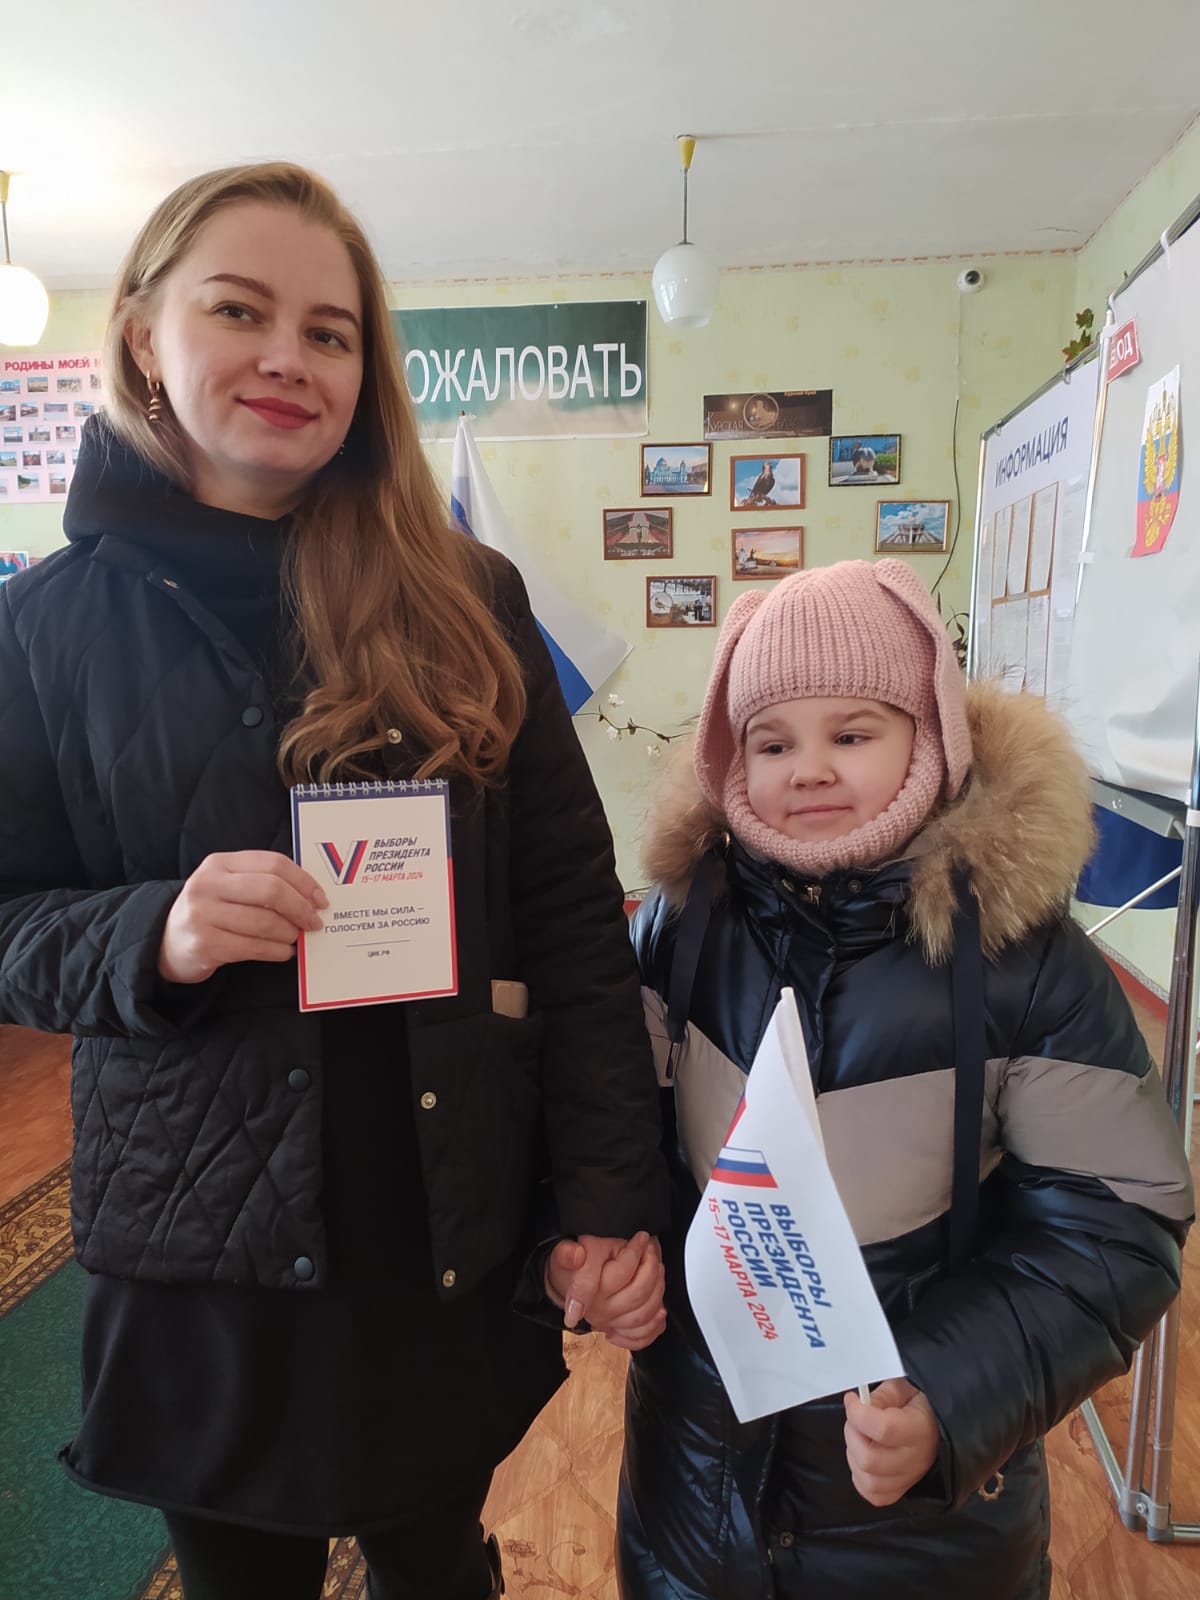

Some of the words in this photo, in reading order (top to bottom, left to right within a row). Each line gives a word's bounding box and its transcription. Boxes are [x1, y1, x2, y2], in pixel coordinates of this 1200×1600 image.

[4, 360, 54, 372] РОДИНЫ
[58, 357, 90, 369] МОЕЙ
[404, 343, 642, 404] ОЖАЛОВАТЬ
[994, 416, 1069, 489] ИНФОРМАЦИЯ
[373, 837, 418, 849] ВЫБОРЫ
[369, 848, 431, 861] ПРЕЗИДЕНТА
[364, 862, 405, 873] РОССИИ
[382, 873, 405, 882] МАРТА
[333, 909, 370, 921] ВМЕСТЕ
[372, 908, 388, 917] МЫ
[390, 906, 415, 916] СИЛА
[325, 922, 376, 934] ГОЛОСУЕМ
[377, 920, 389, 930] ЗА
[391, 917, 430, 928] РОССИЮ
[722, 1199, 778, 1289] РОССИИ
[769, 1203, 832, 1308] ВЫБОРЫ
[744, 1202, 826, 1349] ПРЕЗИДЕНТА
[720, 1244, 758, 1299] МАРТА
[747, 1301, 779, 1341] 2024
